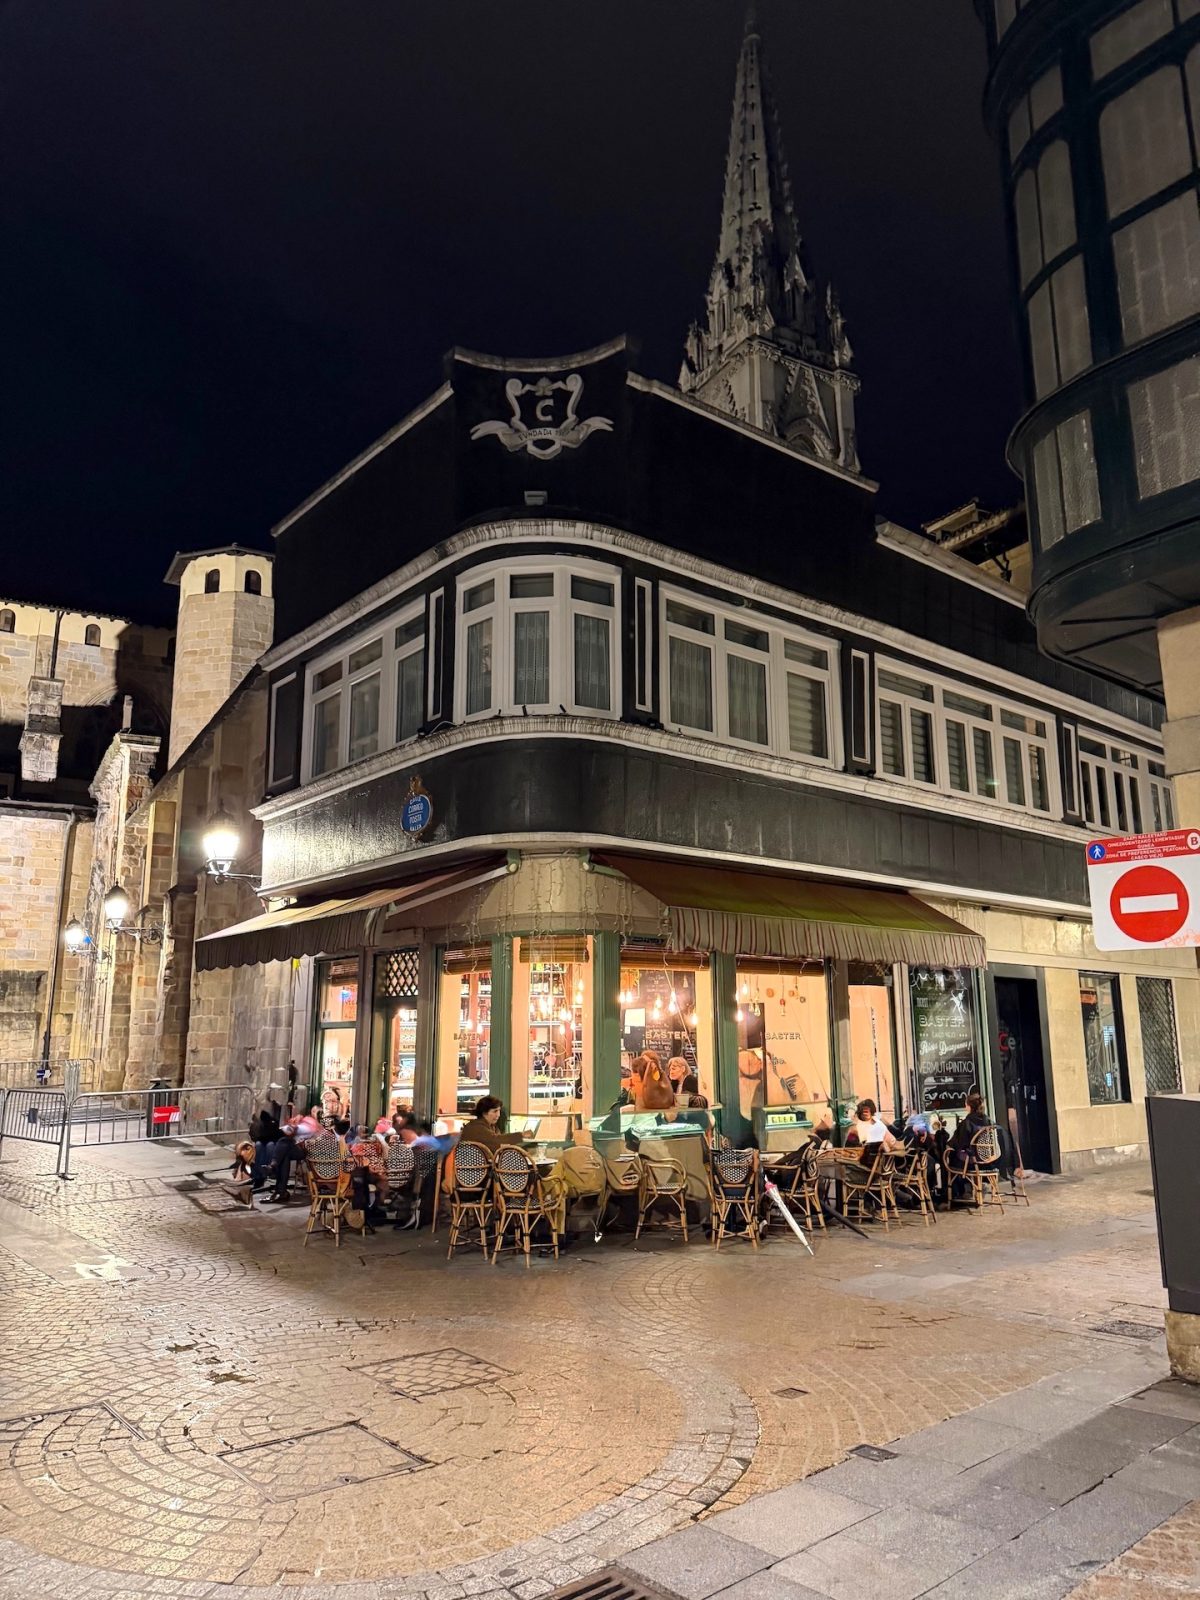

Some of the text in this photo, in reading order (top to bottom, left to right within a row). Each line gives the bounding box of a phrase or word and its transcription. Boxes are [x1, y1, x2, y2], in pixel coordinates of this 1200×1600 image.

[536, 399, 554, 421] C
[1190, 836, 1199, 846] B
[919, 1015, 965, 1027] BASTER
[453, 1033, 480, 1041] BASTER
[645, 1031, 688, 1039] BASTER
[765, 1032, 801, 1040] BASTER
